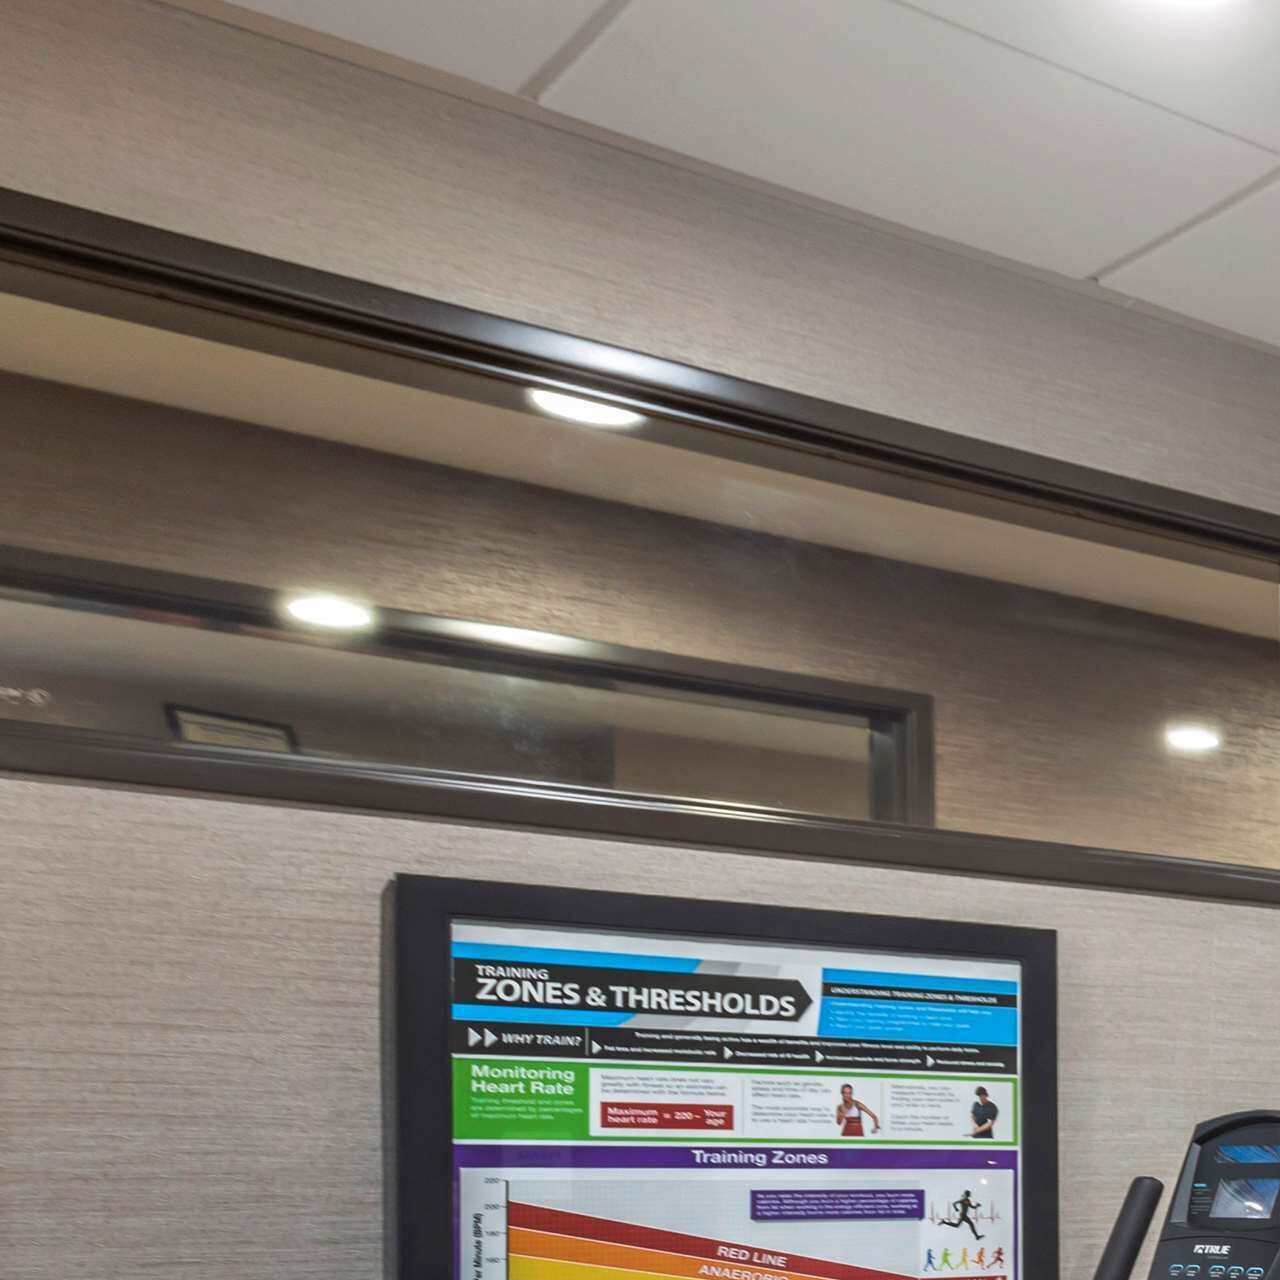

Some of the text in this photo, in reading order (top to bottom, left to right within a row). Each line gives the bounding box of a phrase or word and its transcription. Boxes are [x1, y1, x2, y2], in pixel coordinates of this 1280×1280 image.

[475, 964, 549, 980] TRAINING
[475, 977, 796, 1018] ZONES & THRESHOLDS
[501, 1032, 583, 1047] WHY TRAIN?
[471, 1064, 575, 1083] Monitoring
[471, 1080, 574, 1096] Heart Rate
[607, 1107, 658, 1116] Maximum
[607, 1115, 636, 1123] heart
[704, 1109, 727, 1118] Your
[691, 1149, 828, 1167] Training Zones
[717, 1245, 787, 1267] RED LINE
[1204, 1245, 1231, 1254] TRUE
